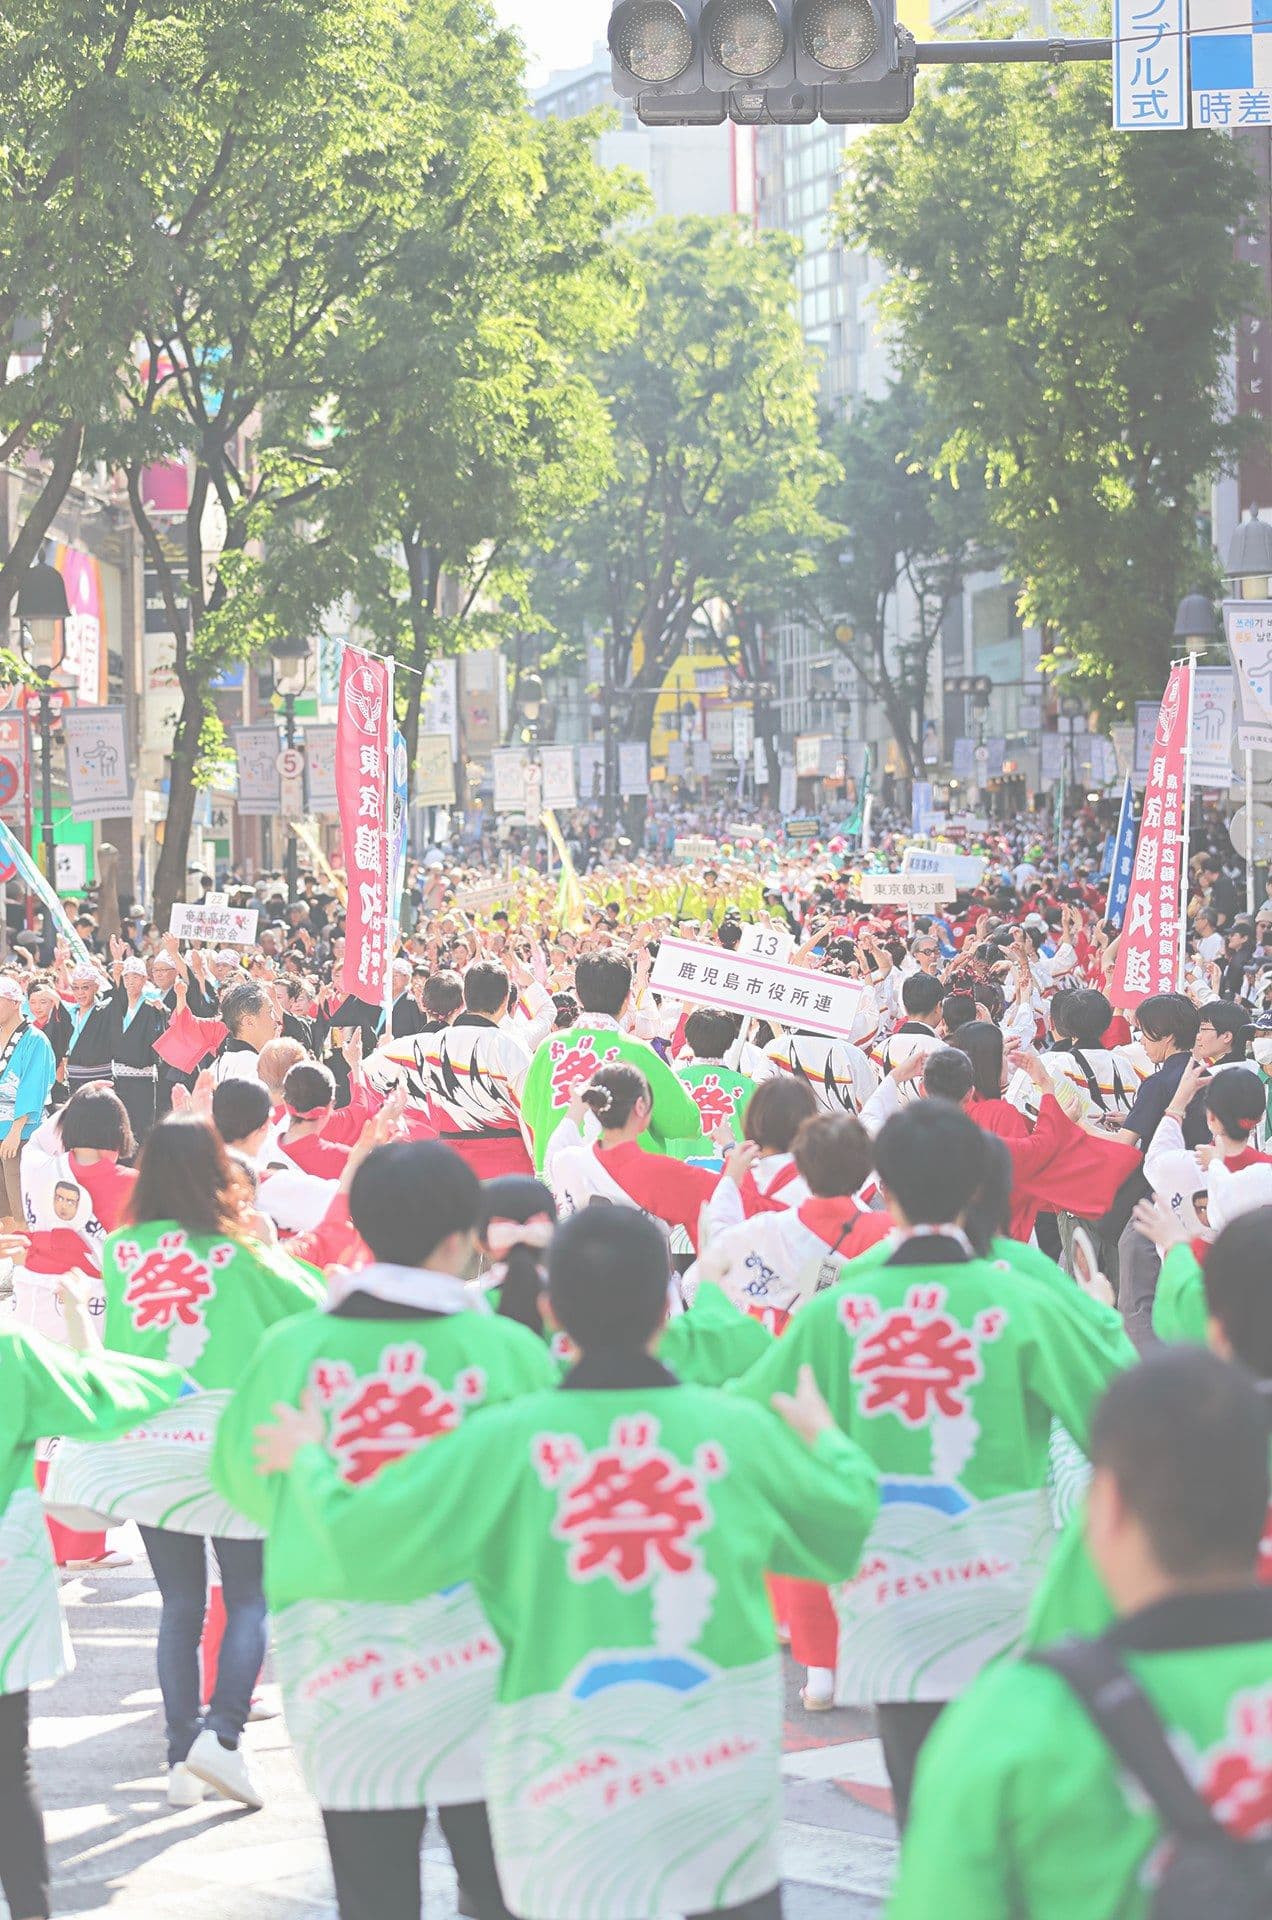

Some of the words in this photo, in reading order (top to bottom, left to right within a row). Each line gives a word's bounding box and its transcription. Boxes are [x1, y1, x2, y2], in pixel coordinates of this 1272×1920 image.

[284, 753, 296, 773] 5
[872, 882, 945, 896] 東京鶴丸連
[185, 909, 231, 926] 奄美高校
[752, 933, 780, 956] 13
[677, 961, 834, 1014] 鹿児島市役所連
[126, 1250, 211, 1328] 祭
[854, 1314, 977, 1421] 祭
[561, 1458, 705, 1581] 祭
[875, 1556, 1013, 1605] FESTIVAL
[370, 1637, 497, 1700] FESTIVA
